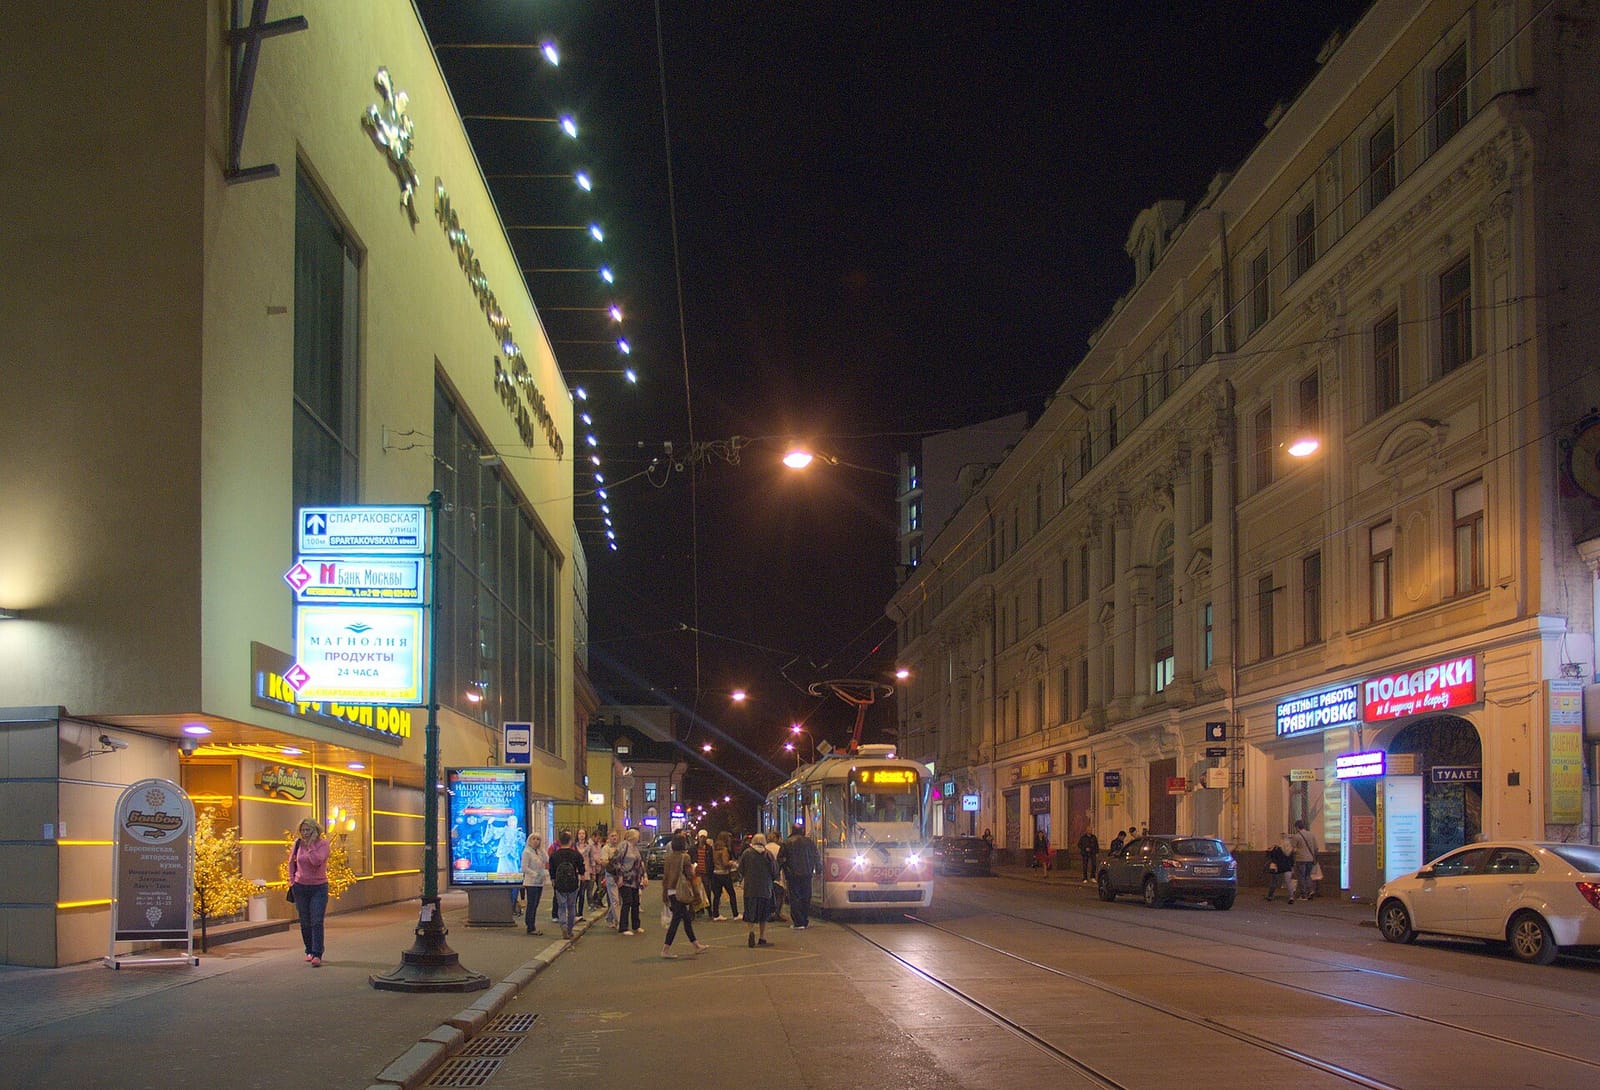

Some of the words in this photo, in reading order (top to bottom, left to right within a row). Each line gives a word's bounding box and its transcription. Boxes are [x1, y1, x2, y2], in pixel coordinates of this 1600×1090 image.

[329, 513, 418, 524] СПАРТАКОВСКАЯ
[331, 536, 398, 545] SPARTAKOVSKAYA
[338, 569, 361, 585] Банк
[364, 569, 402, 586] Москвы
[310, 636, 408, 647] МАГНОЛИЯ
[324, 652, 394, 662] ПРОДУКТЫ
[337, 668, 349, 677] 24
[353, 669, 379, 677] ЧАСА
[1365, 658, 1473, 706] ПОДАРКИ
[1278, 694, 1319, 716] БАГЕТНЫЕ
[1320, 686, 1357, 706] РАБОТЫ
[1278, 701, 1357, 735] ГРАВИРОВКА
[1437, 771, 1479, 779] ТУАЛЕТ
